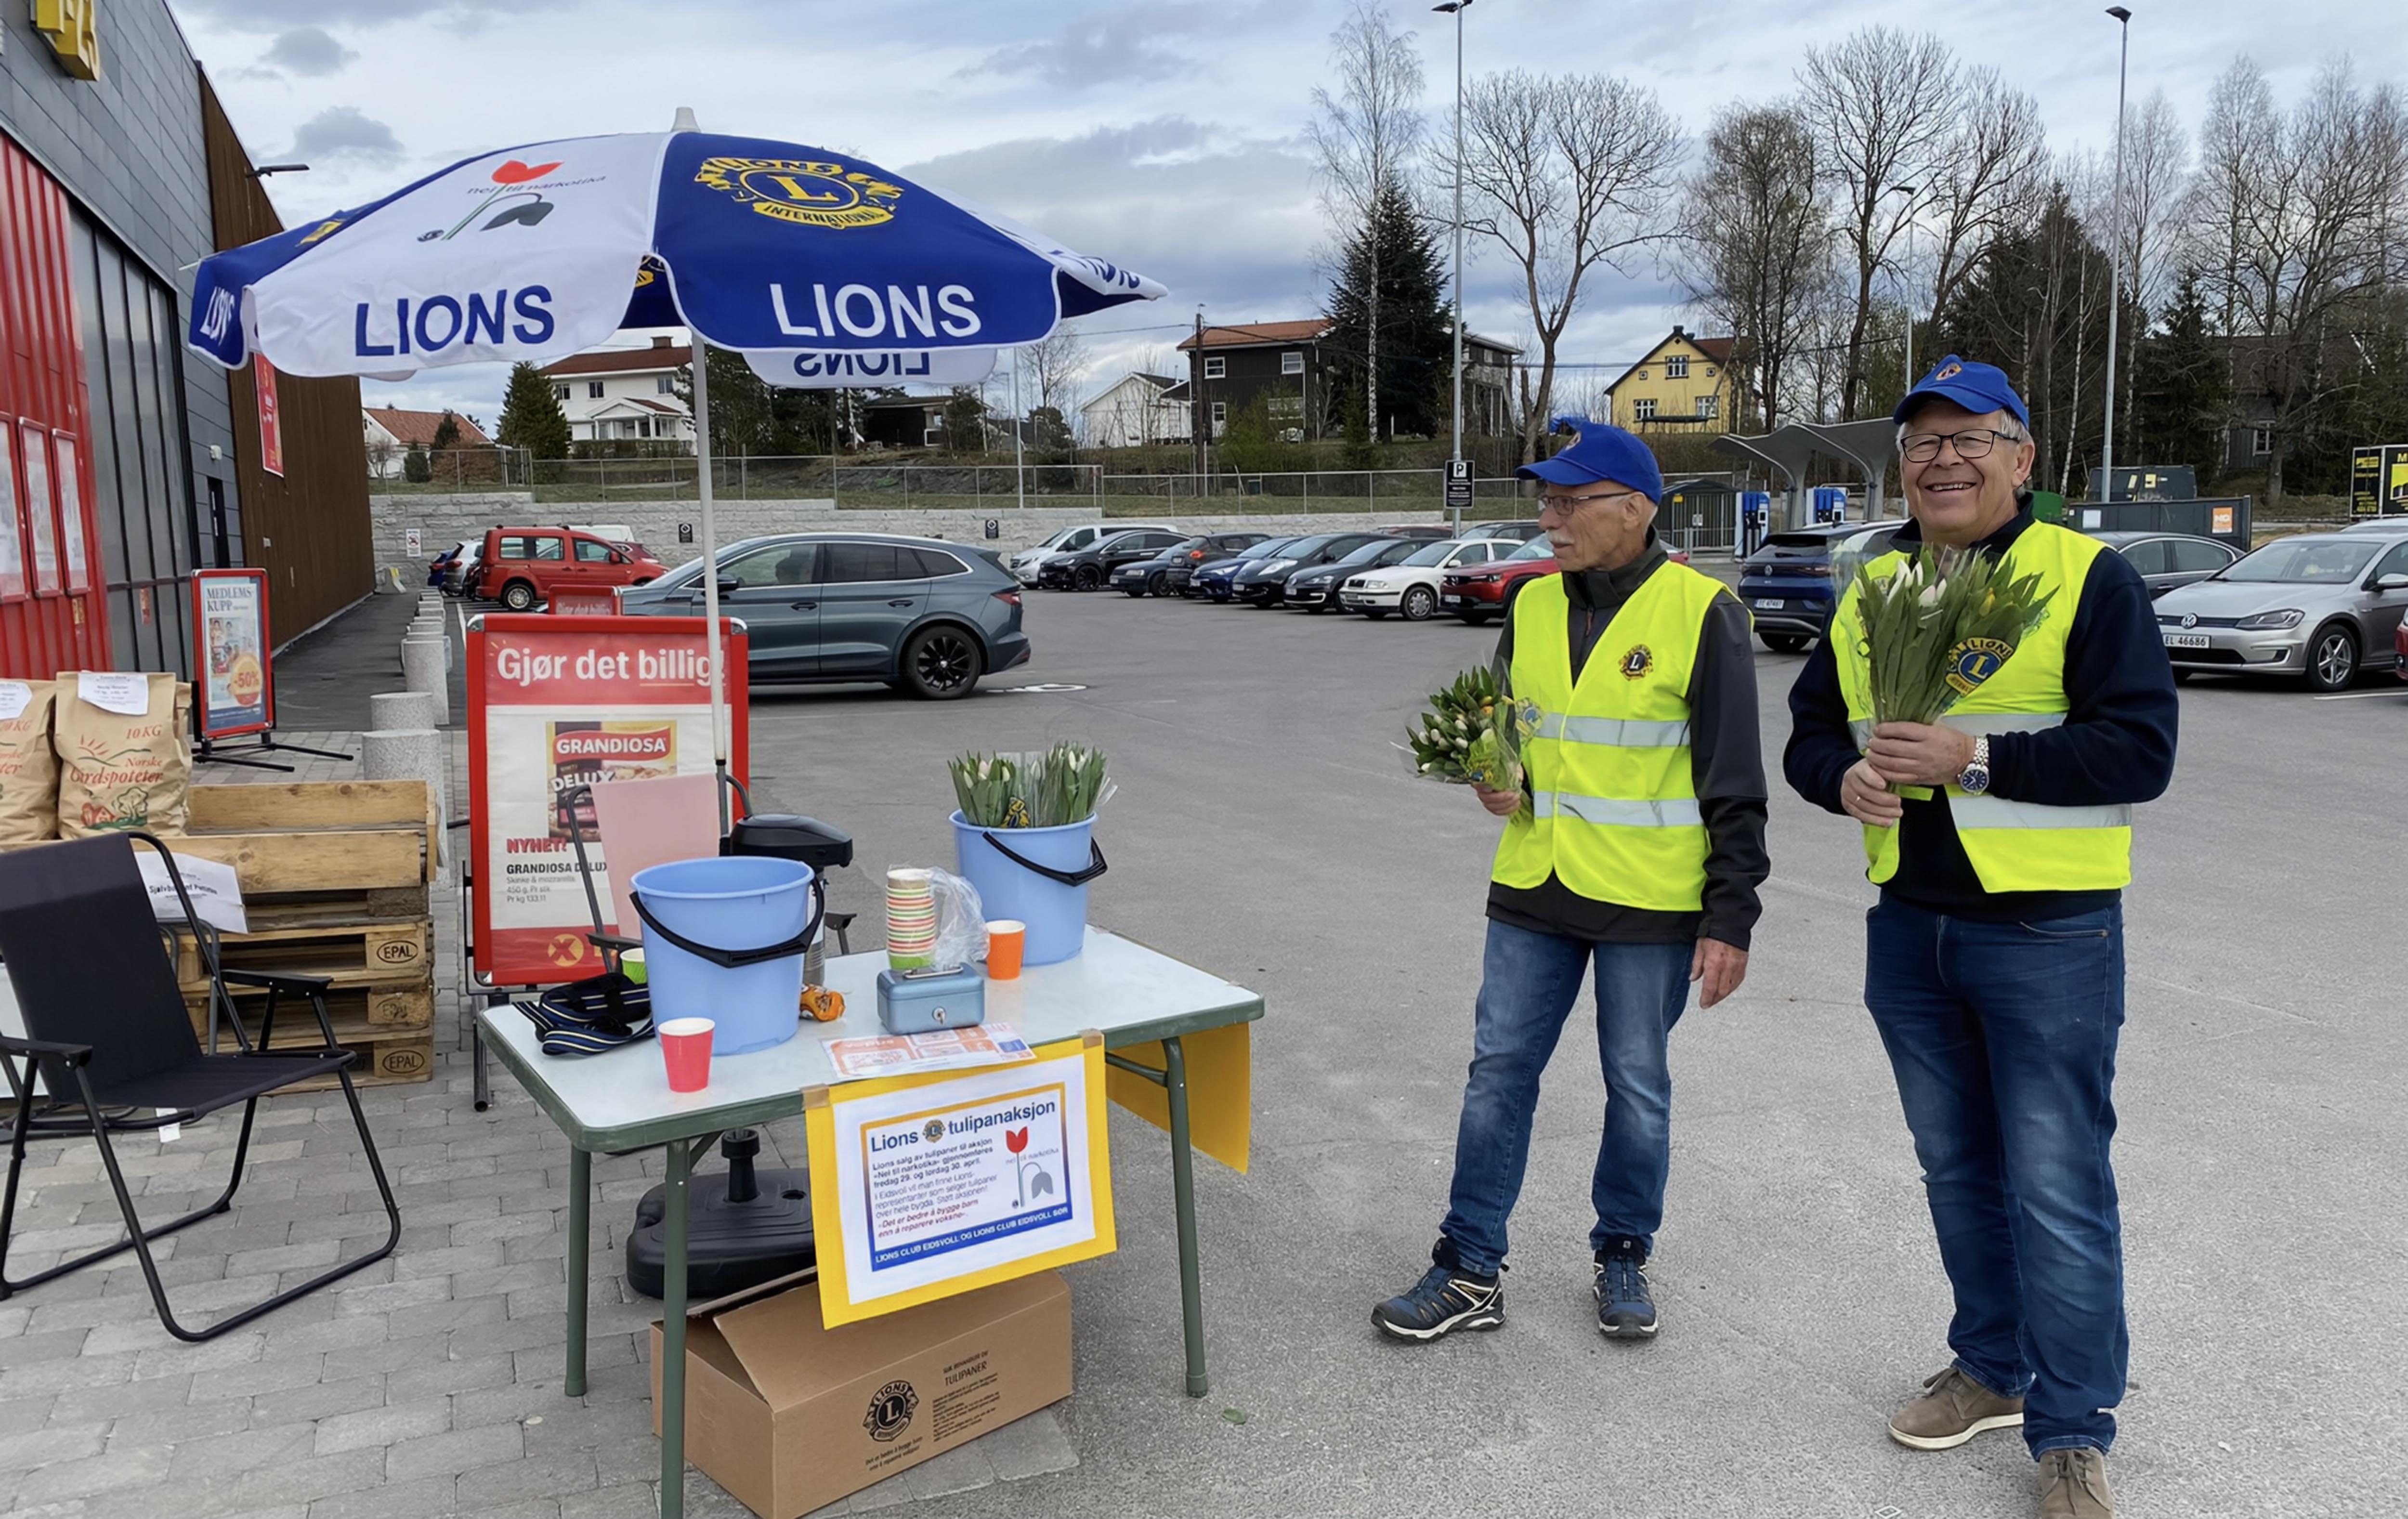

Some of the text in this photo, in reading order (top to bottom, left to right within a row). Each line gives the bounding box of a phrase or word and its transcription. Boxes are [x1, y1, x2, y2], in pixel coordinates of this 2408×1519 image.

[770, 283, 981, 338] LIONS
[355, 285, 554, 356] LIONS
[2397, 453, 2408, 462] M
[1456, 464, 1464, 475] P
[206, 586, 253, 600] MEDLEMS-
[207, 600, 232, 612] KUPP
[2165, 636, 2206, 646] EL 46686
[497, 648, 567, 686] Gjør
[576, 649, 629, 680] det
[1630, 654, 1640, 669] L
[1968, 655, 1989, 680] L
[126, 725, 162, 740] 10 KG
[557, 738, 665, 754] GRANDIOSA
[125, 757, 163, 767] Norske
[550, 770, 615, 792] DELUX
[507, 837, 567, 853] NYHET!
[507, 863, 572, 874] GRANDIOSA
[516, 895, 525, 904] kg
[384, 944, 413, 959] EPAL
[389, 1054, 418, 1069] EPAL
[871, 1101, 1055, 1152] Lions tulipanaksjon
[872, 1160, 894, 1171] Lions
[896, 1156, 913, 1165] salg
[924, 1146, 957, 1158] tulipaner
[968, 1138, 992, 1148] aksjon
[942, 1146, 993, 1165] gjennomføres
[873, 1177, 899, 1188] fredag
[913, 1171, 923, 1179] og
[929, 1187, 944, 1197] som
[968, 1174, 997, 1187] tulipaner
[879, 1186, 907, 1199] Eidsvoll
[917, 1180, 934, 1190] man
[875, 1208, 892, 1218] over
[893, 1205, 909, 1214] hele
[906, 1211, 931, 1222] bedre
[875, 1251, 899, 1263] LIONS
[900, 1244, 921, 1256] CLUB
[922, 1235, 959, 1250] EIDSVOLL
[960, 1231, 972, 1241] OG
[973, 1225, 995, 1237] LIONS
[996, 1220, 1016, 1231] CLUB
[1017, 1211, 1051, 1225] EIDSVOLL
[945, 1361, 987, 1386] TULIPANER
[875, 1382, 907, 1402] LIONS
[885, 1399, 900, 1422] L
